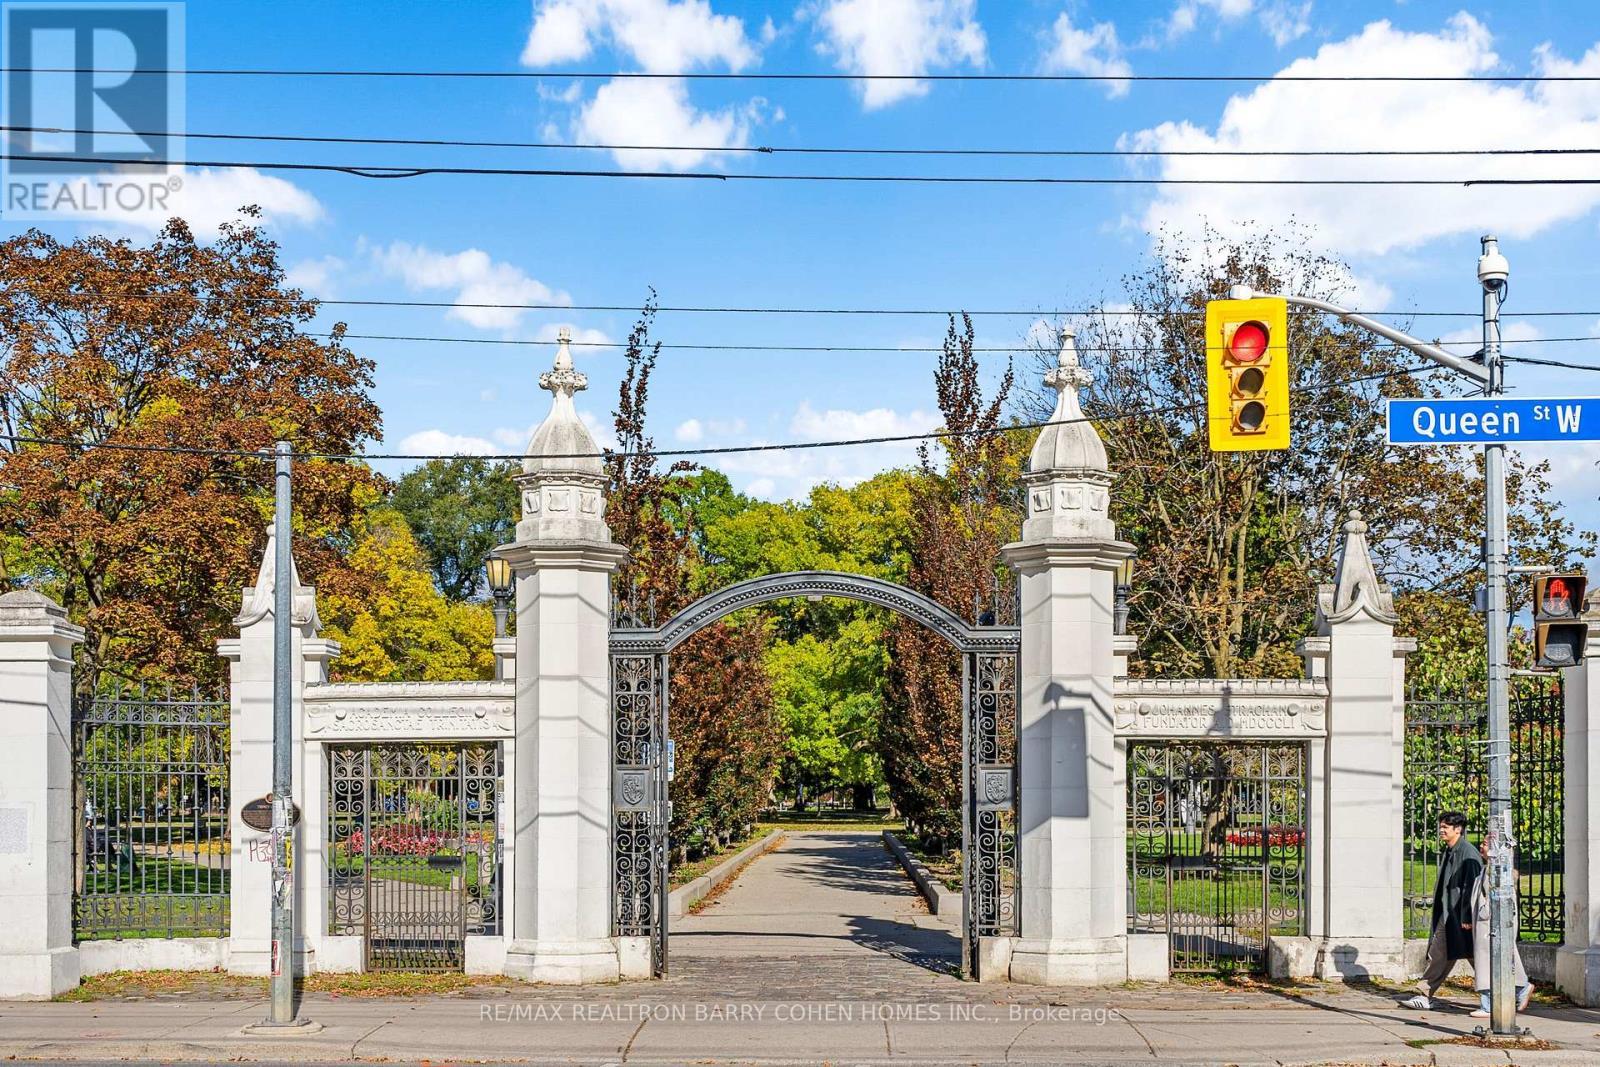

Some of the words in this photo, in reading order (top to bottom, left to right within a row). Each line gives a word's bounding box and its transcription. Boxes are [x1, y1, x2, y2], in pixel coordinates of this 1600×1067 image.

[1412, 406, 1520, 438] Queen
[1533, 405, 1551, 420] St
[1556, 405, 1582, 433] W
[1151, 704, 1215, 716] JOHANNES
[1143, 716, 1208, 729] FUNDATOR
